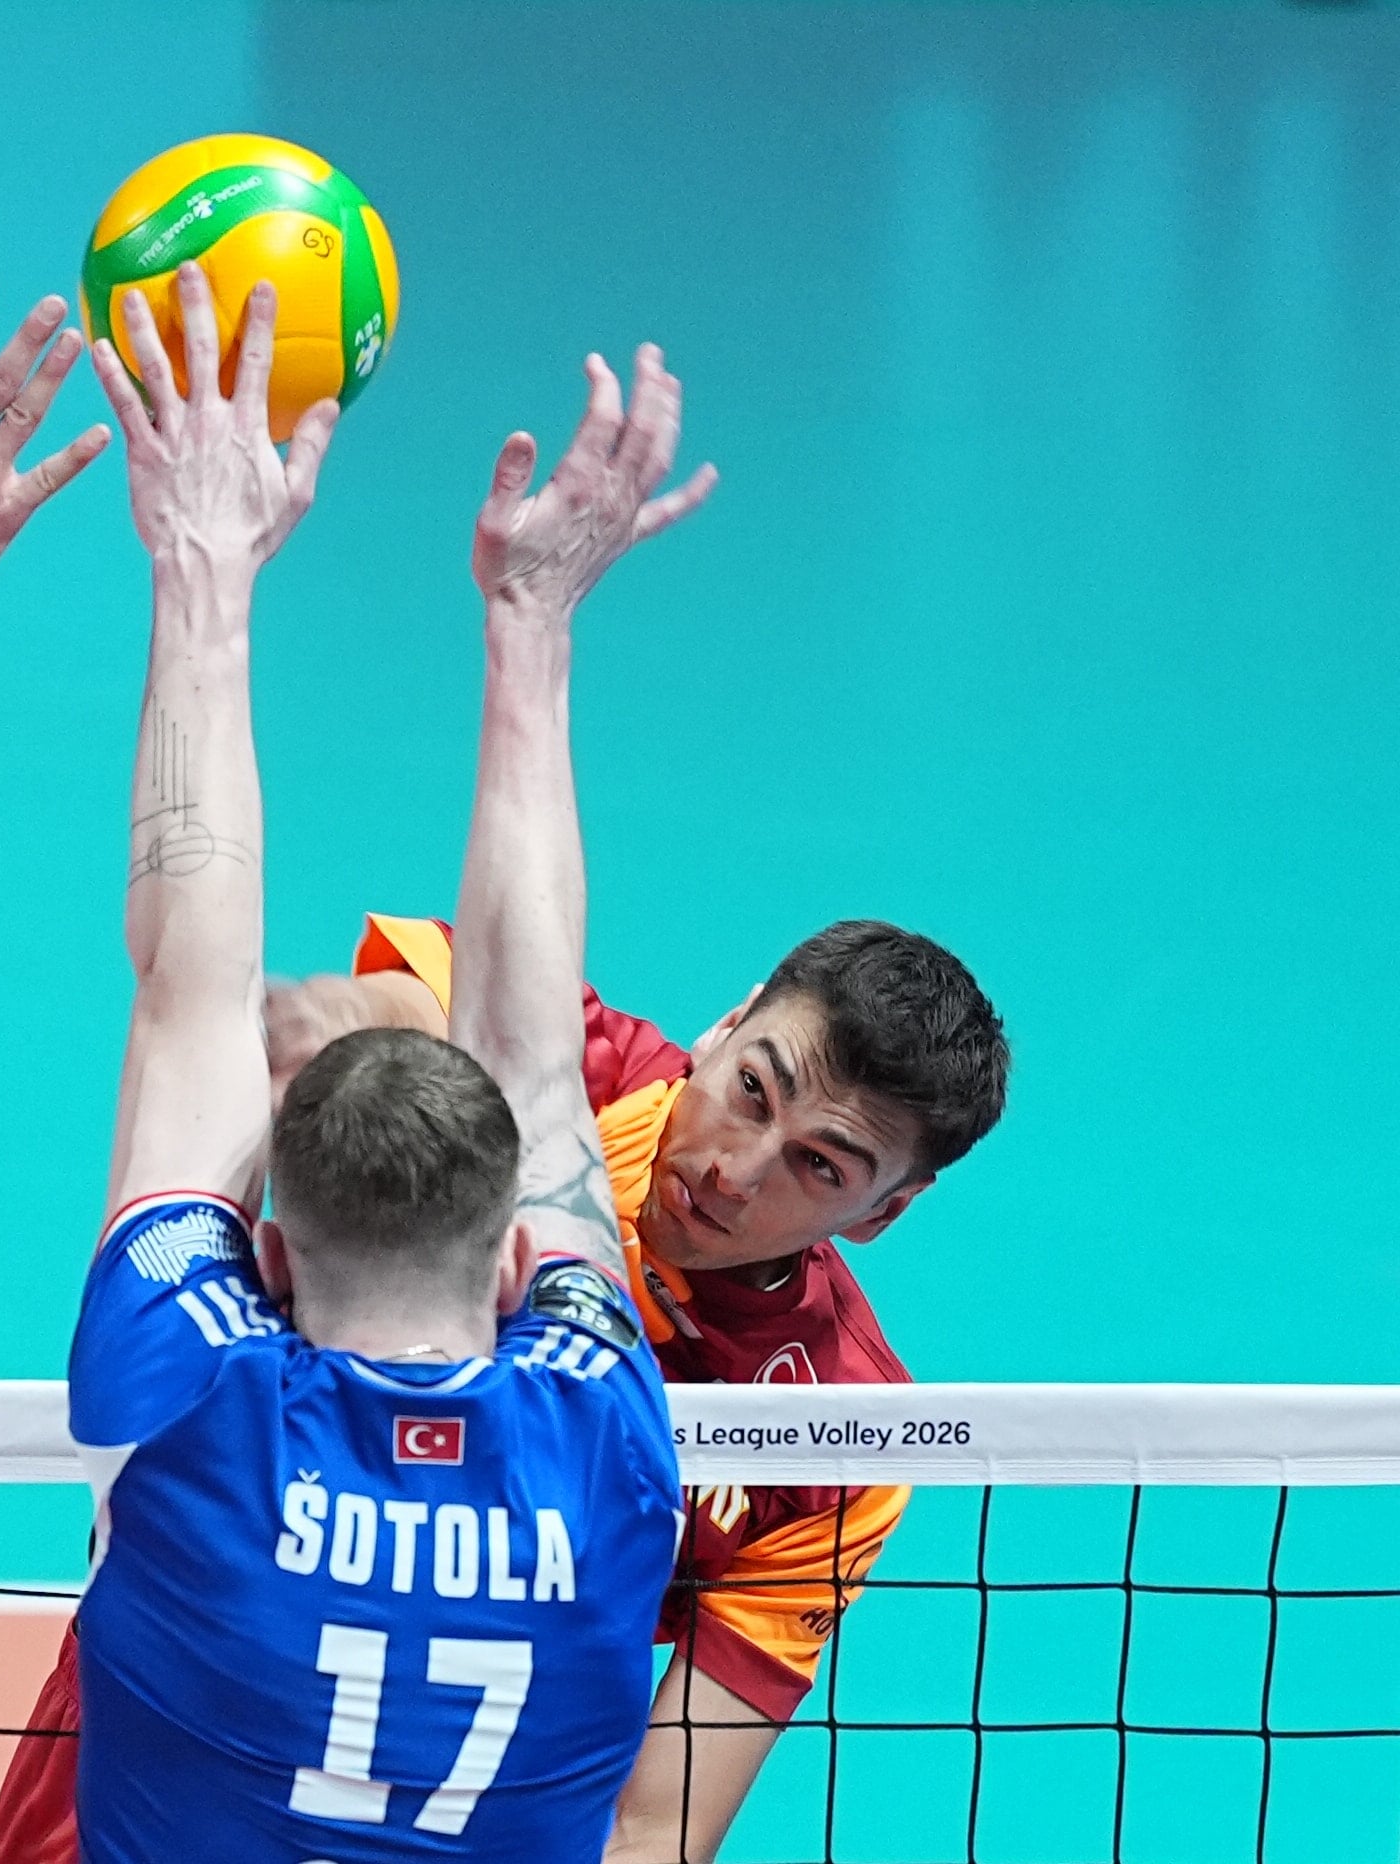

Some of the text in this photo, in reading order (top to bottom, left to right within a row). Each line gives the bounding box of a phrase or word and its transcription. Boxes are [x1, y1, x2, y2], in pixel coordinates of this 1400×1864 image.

[303, 227, 335, 258] GS
[561, 1304, 612, 1331] CEV
[696, 1422, 799, 1450] League
[808, 1421, 892, 1450] Volley
[901, 1421, 971, 1445] 2026
[275, 1469, 577, 1602] ŠOTOLA
[288, 1623, 534, 1836] 17
